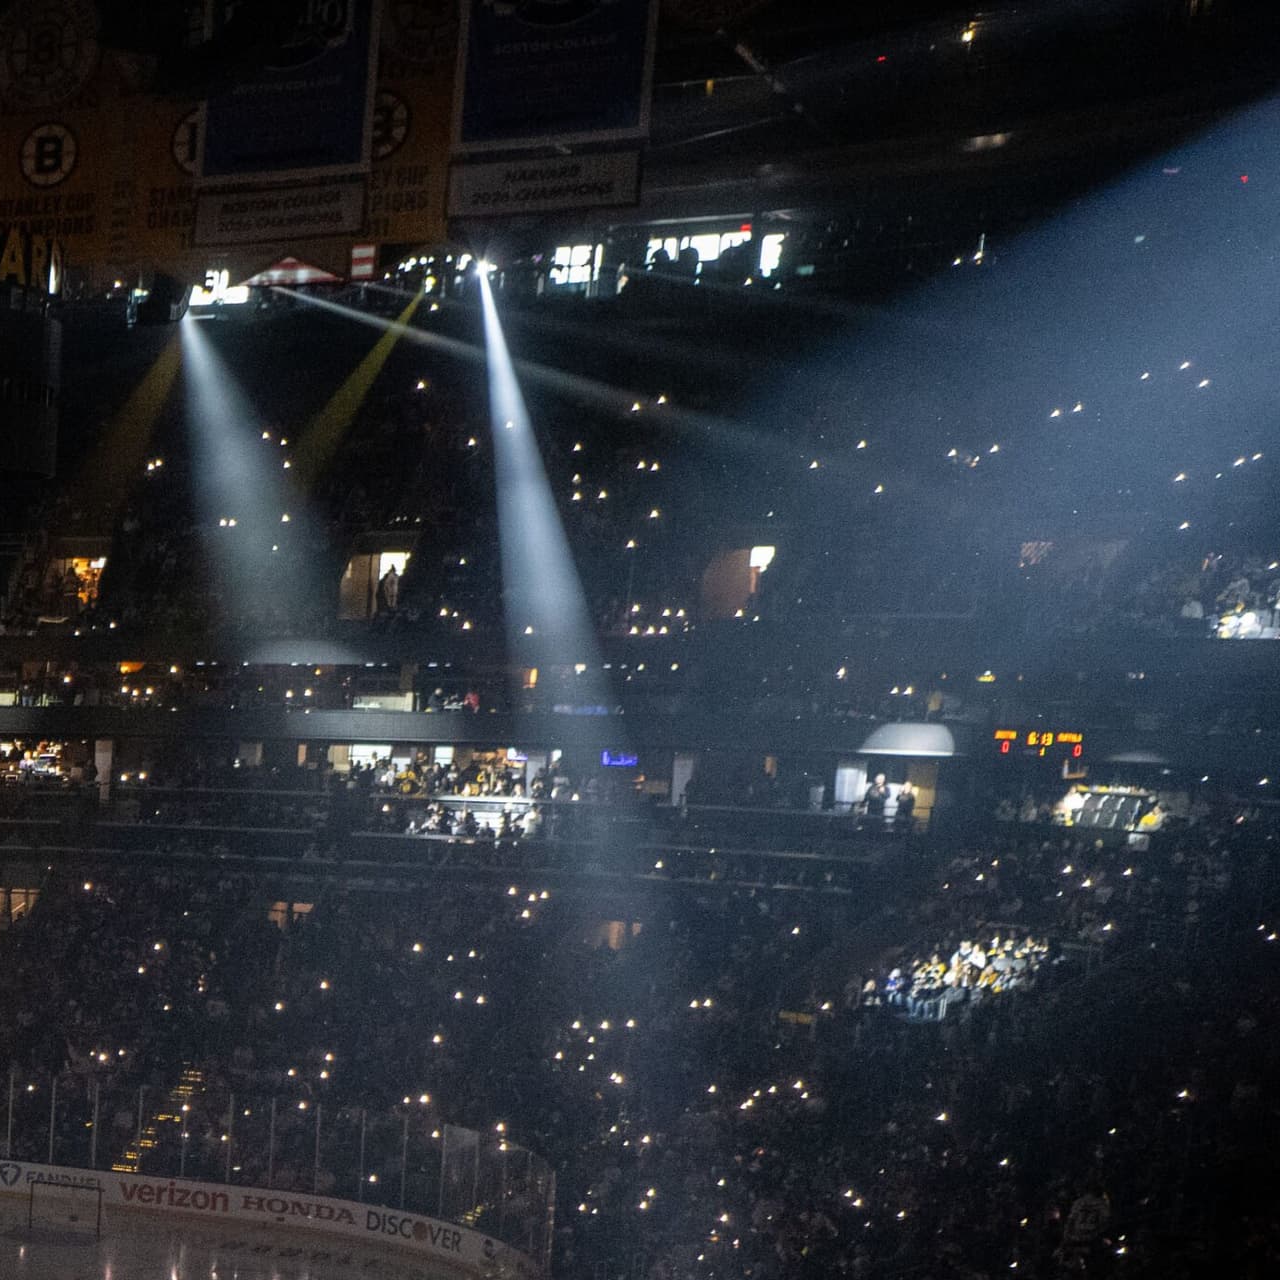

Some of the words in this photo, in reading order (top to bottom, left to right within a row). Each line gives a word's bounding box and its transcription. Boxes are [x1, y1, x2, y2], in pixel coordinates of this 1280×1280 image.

[504, 164, 581, 183] HARVARD
[119, 1180, 230, 1213] verizon
[242, 1194, 357, 1225] HONDA
[366, 1210, 462, 1253] DISCOVER
